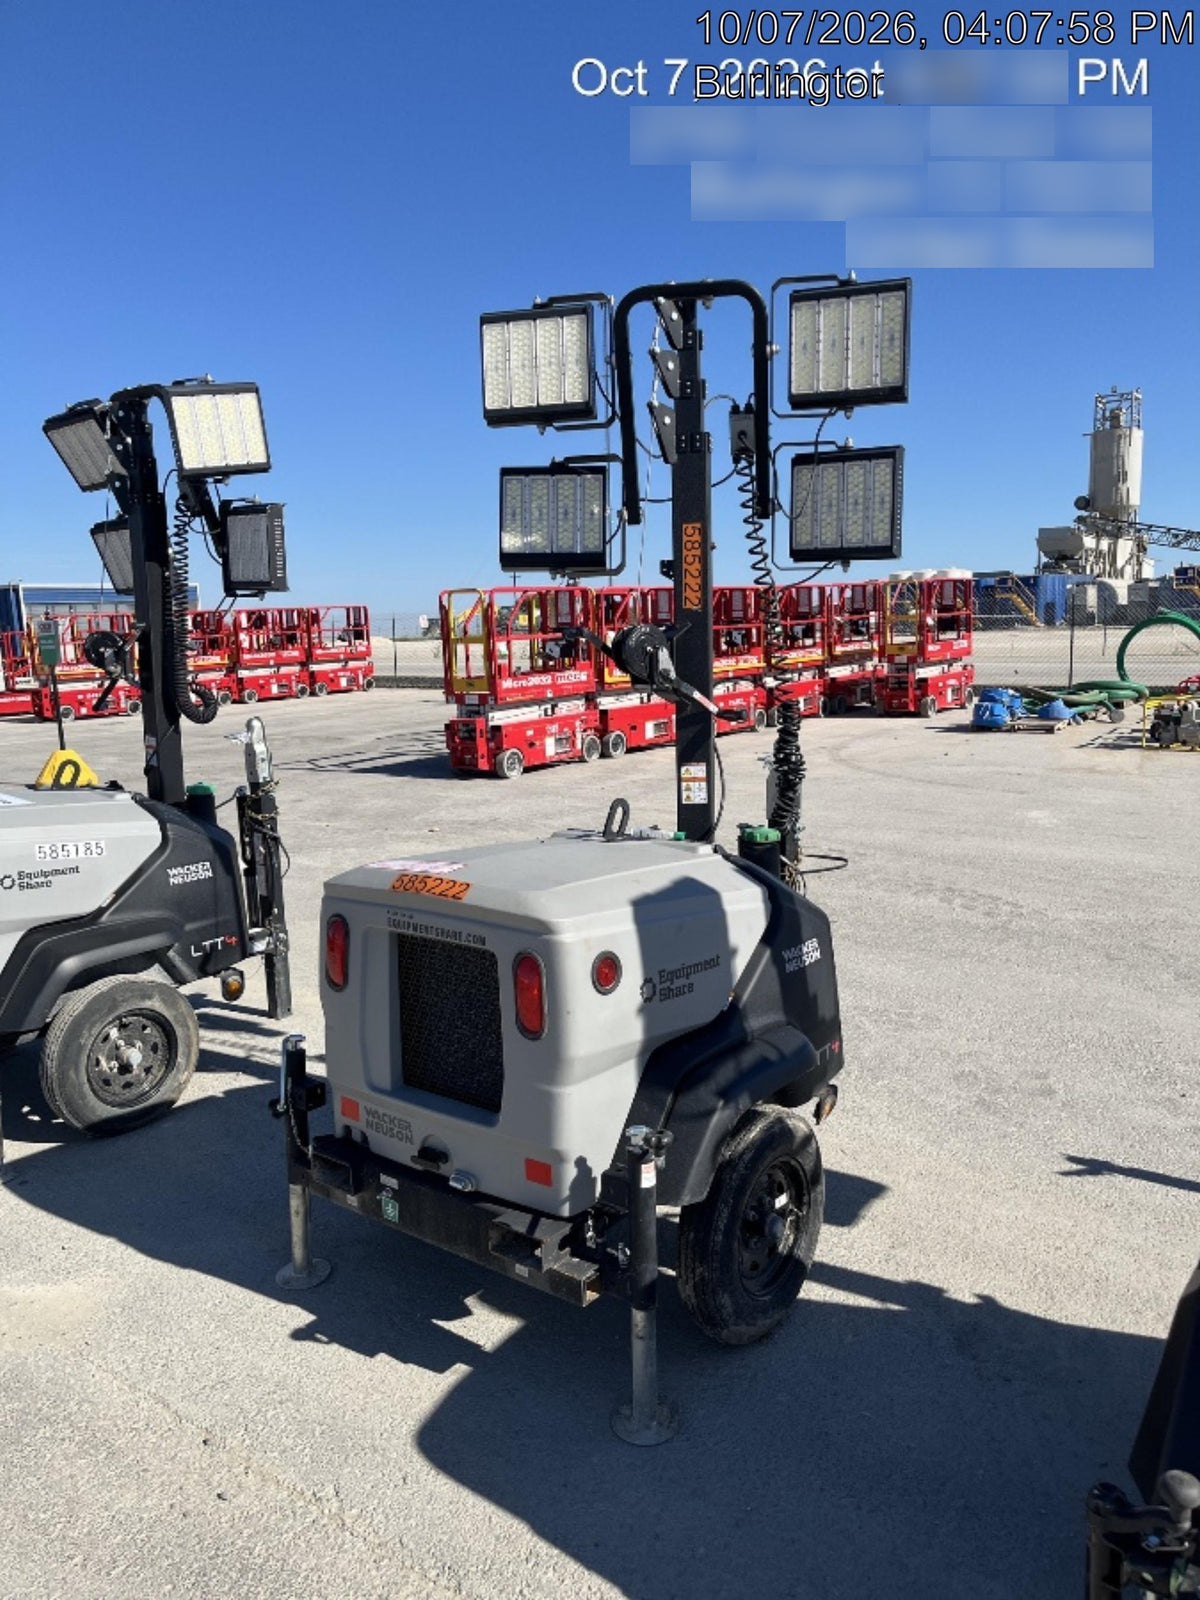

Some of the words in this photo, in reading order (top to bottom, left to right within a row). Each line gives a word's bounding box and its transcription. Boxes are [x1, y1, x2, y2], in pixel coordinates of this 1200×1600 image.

[684, 525, 702, 607] 585222
[38, 842, 104, 860] 585185
[17, 865, 80, 881] Equipment
[18, 880, 52, 891] Share
[392, 874, 470, 900] 585222
[387, 917, 486, 946] EQUIPMENTSHARE.COM
[658, 954, 720, 985] Equipment
[659, 982, 694, 1002] Share
[364, 1105, 412, 1131] WACKER
[366, 1118, 414, 1146] NEUSON
